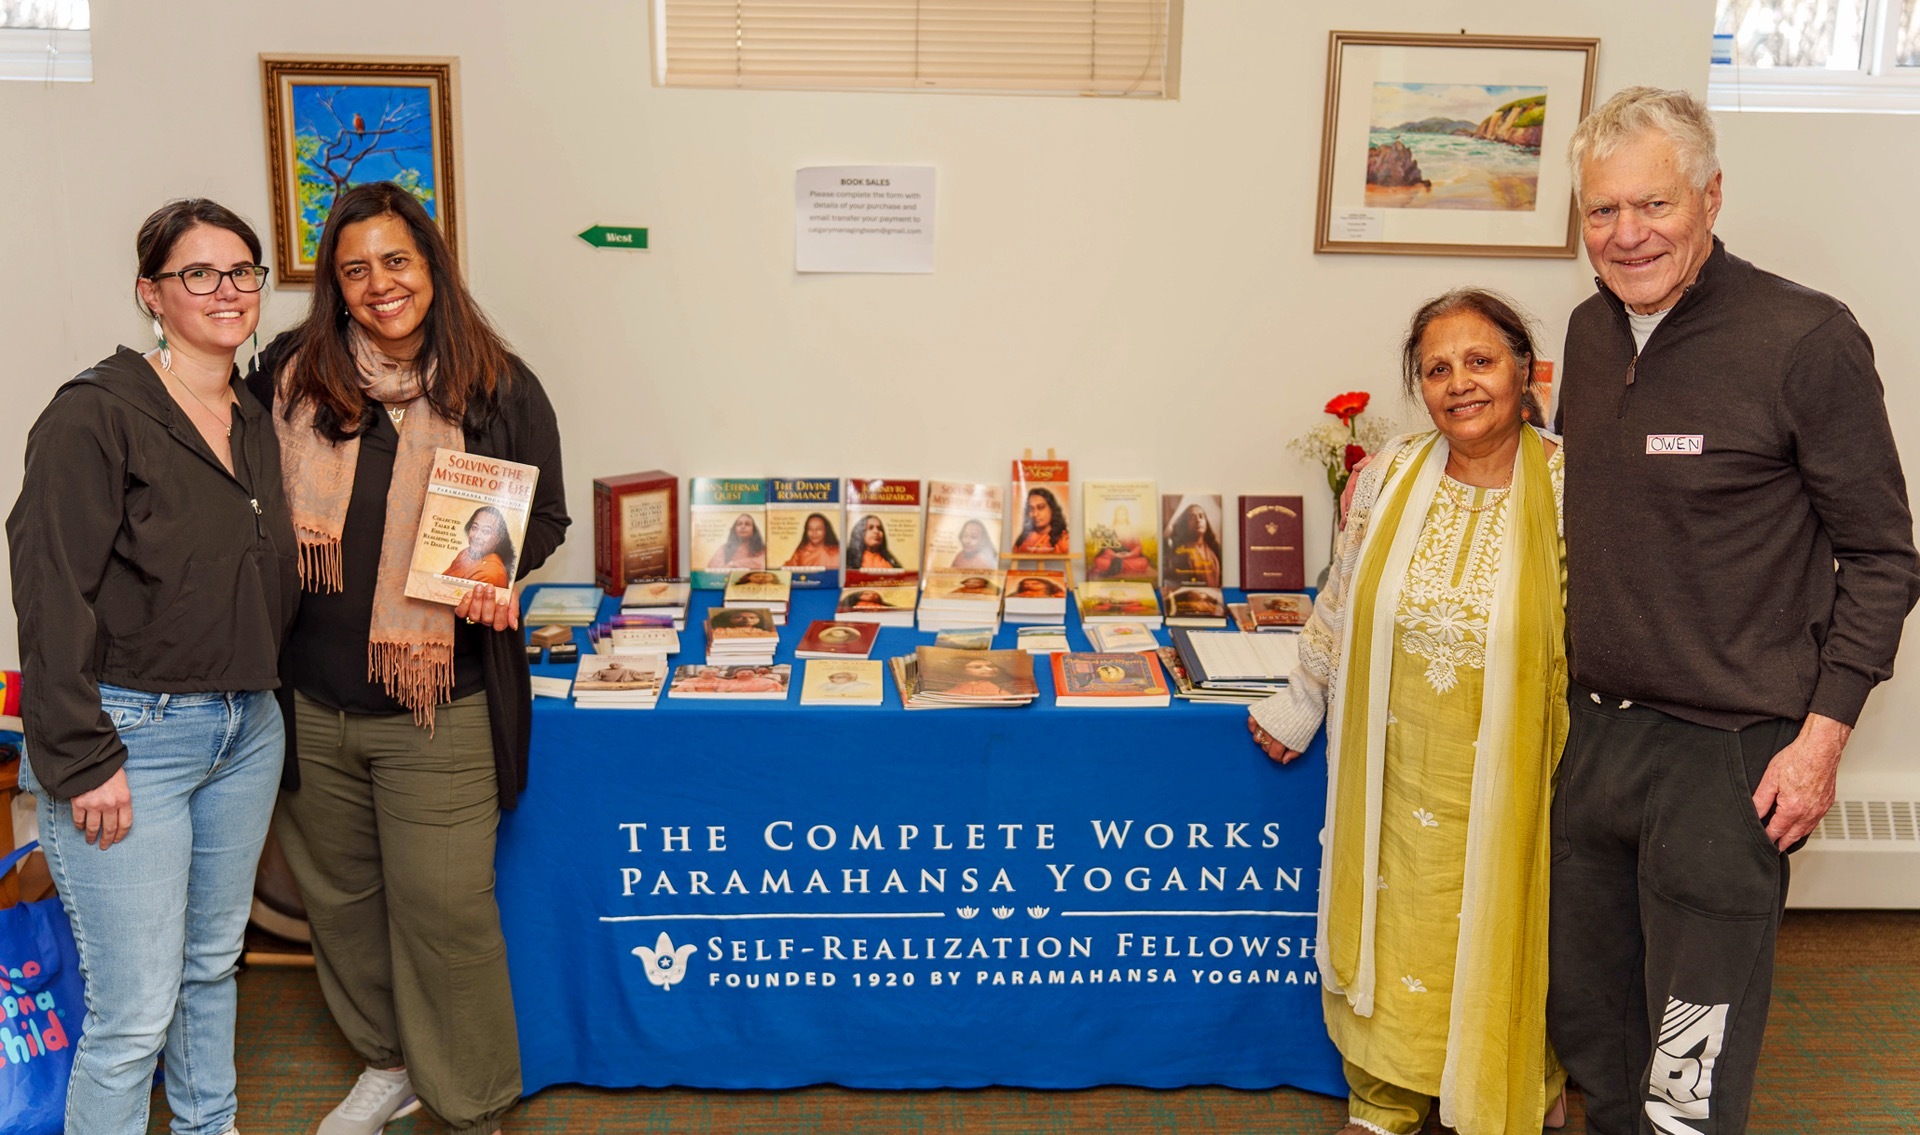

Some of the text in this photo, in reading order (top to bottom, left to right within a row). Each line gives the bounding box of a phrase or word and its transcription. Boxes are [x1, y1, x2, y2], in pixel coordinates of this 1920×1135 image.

[809, 190, 922, 200] Please complete the form with
[813, 201, 839, 209] details
[840, 201, 848, 209] of
[849, 203, 865, 211] your
[866, 202, 901, 211] purchase
[809, 214, 830, 222] email
[831, 214, 861, 222] transfer
[861, 216, 878, 224] your
[879, 216, 912, 224] payment
[605, 232, 633, 243] West
[1651, 437, 1699, 451] OWEN
[448, 454, 524, 480] SOLVING THE
[434, 467, 530, 496] MYSTERY OF LIFE
[774, 480, 832, 491] THE DIVINE
[777, 491, 828, 501] ROMANCE
[432, 514, 462, 525] COLLECTED
[434, 521, 450, 530] TALKS
[431, 528, 449, 537] ESSAYS
[430, 541, 446, 549] DAILY
[619, 820, 1280, 852] THE COMPLETE WORKS
[620, 864, 1321, 896] PARAMAHANSA YOGANAN
[708, 935, 1092, 962] SELF-REALIZATION
[709, 968, 1318, 989] FOUNDED 1920 BY PARAMAHANSA YOGANAN
[0, 1010, 69, 1070] hild
